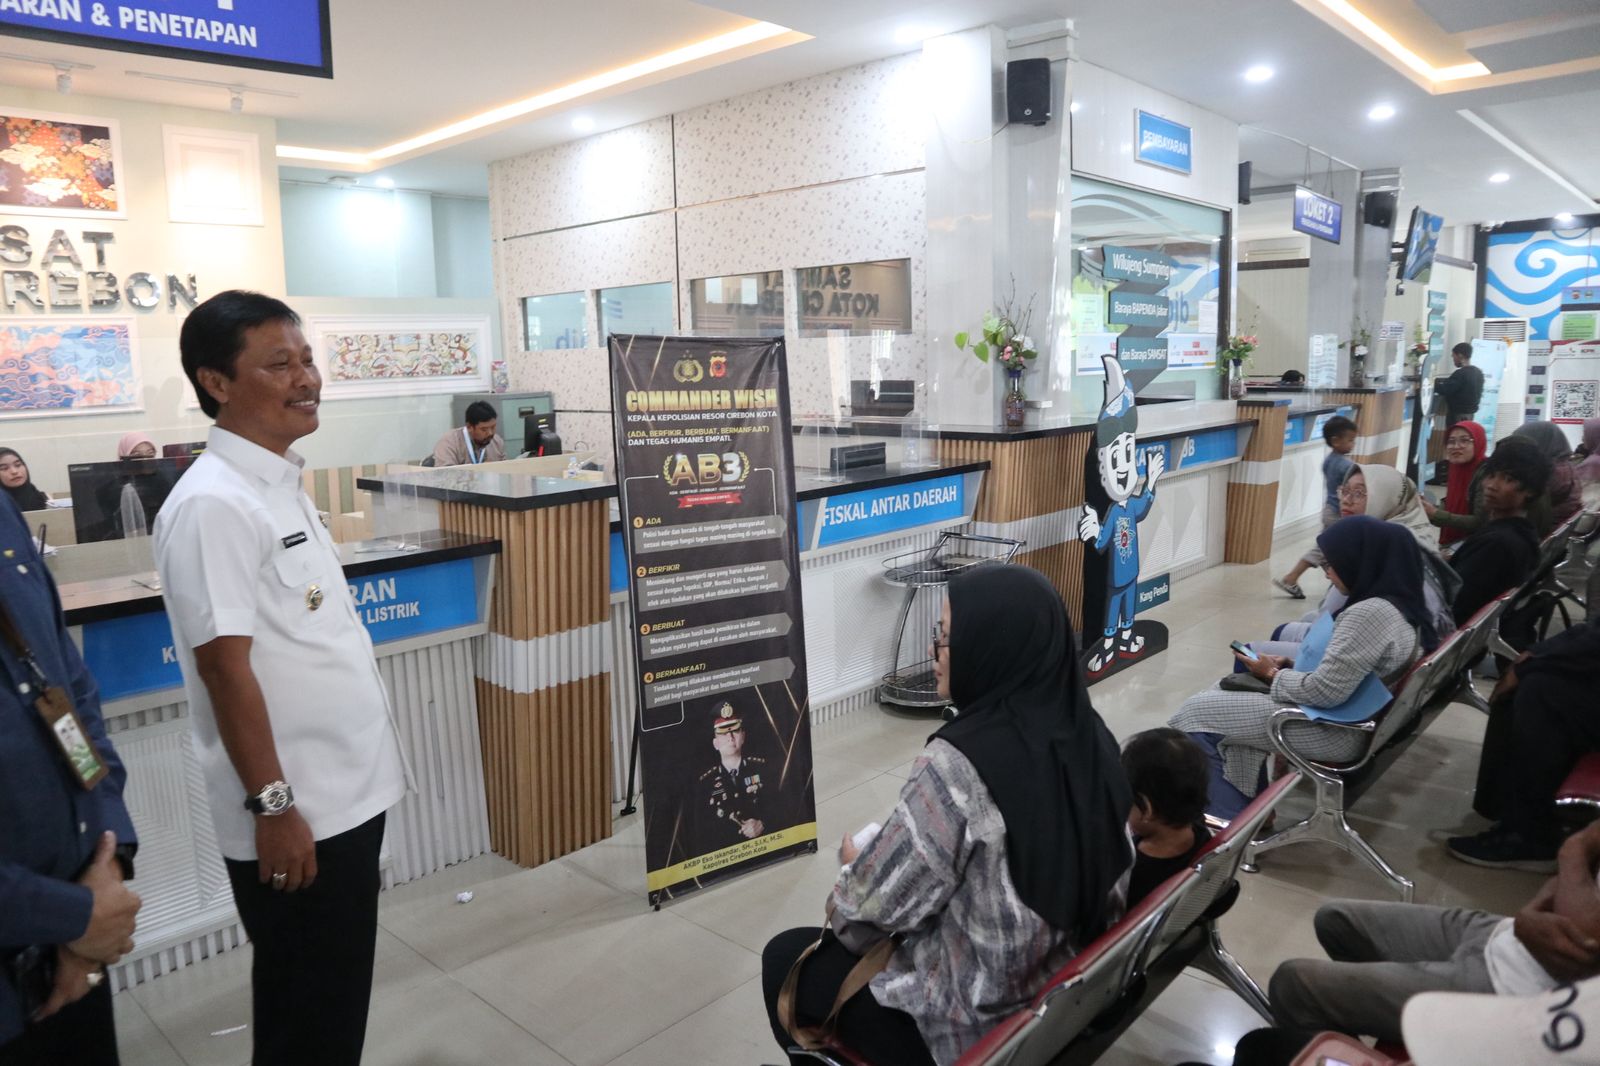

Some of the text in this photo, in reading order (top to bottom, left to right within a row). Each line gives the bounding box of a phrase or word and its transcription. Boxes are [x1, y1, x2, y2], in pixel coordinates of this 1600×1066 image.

[91, 3, 111, 27] &
[119, 7, 257, 47] PENETAPAN
[1143, 130, 1188, 156] PEMBAYARAN
[1303, 196, 1334, 224] LOKET 2
[1112, 253, 1169, 280] Wilujeng Sumping
[626, 389, 777, 412] COMMANDER WISH
[672, 452, 741, 485] AB3
[823, 485, 956, 526] FISKAL ANTAR DAERAH
[648, 564, 680, 574] BERFIKIR
[1140, 583, 1168, 602] Kang Penda
[367, 602, 419, 624] LISTRIK
[652, 620, 685, 631] BERBUAT
[656, 664, 706, 679] BERMANFAAT)
[683, 860, 700, 870] AKBP
[703, 860, 728, 870] Kapolres
[730, 851, 752, 861] Cirebon
